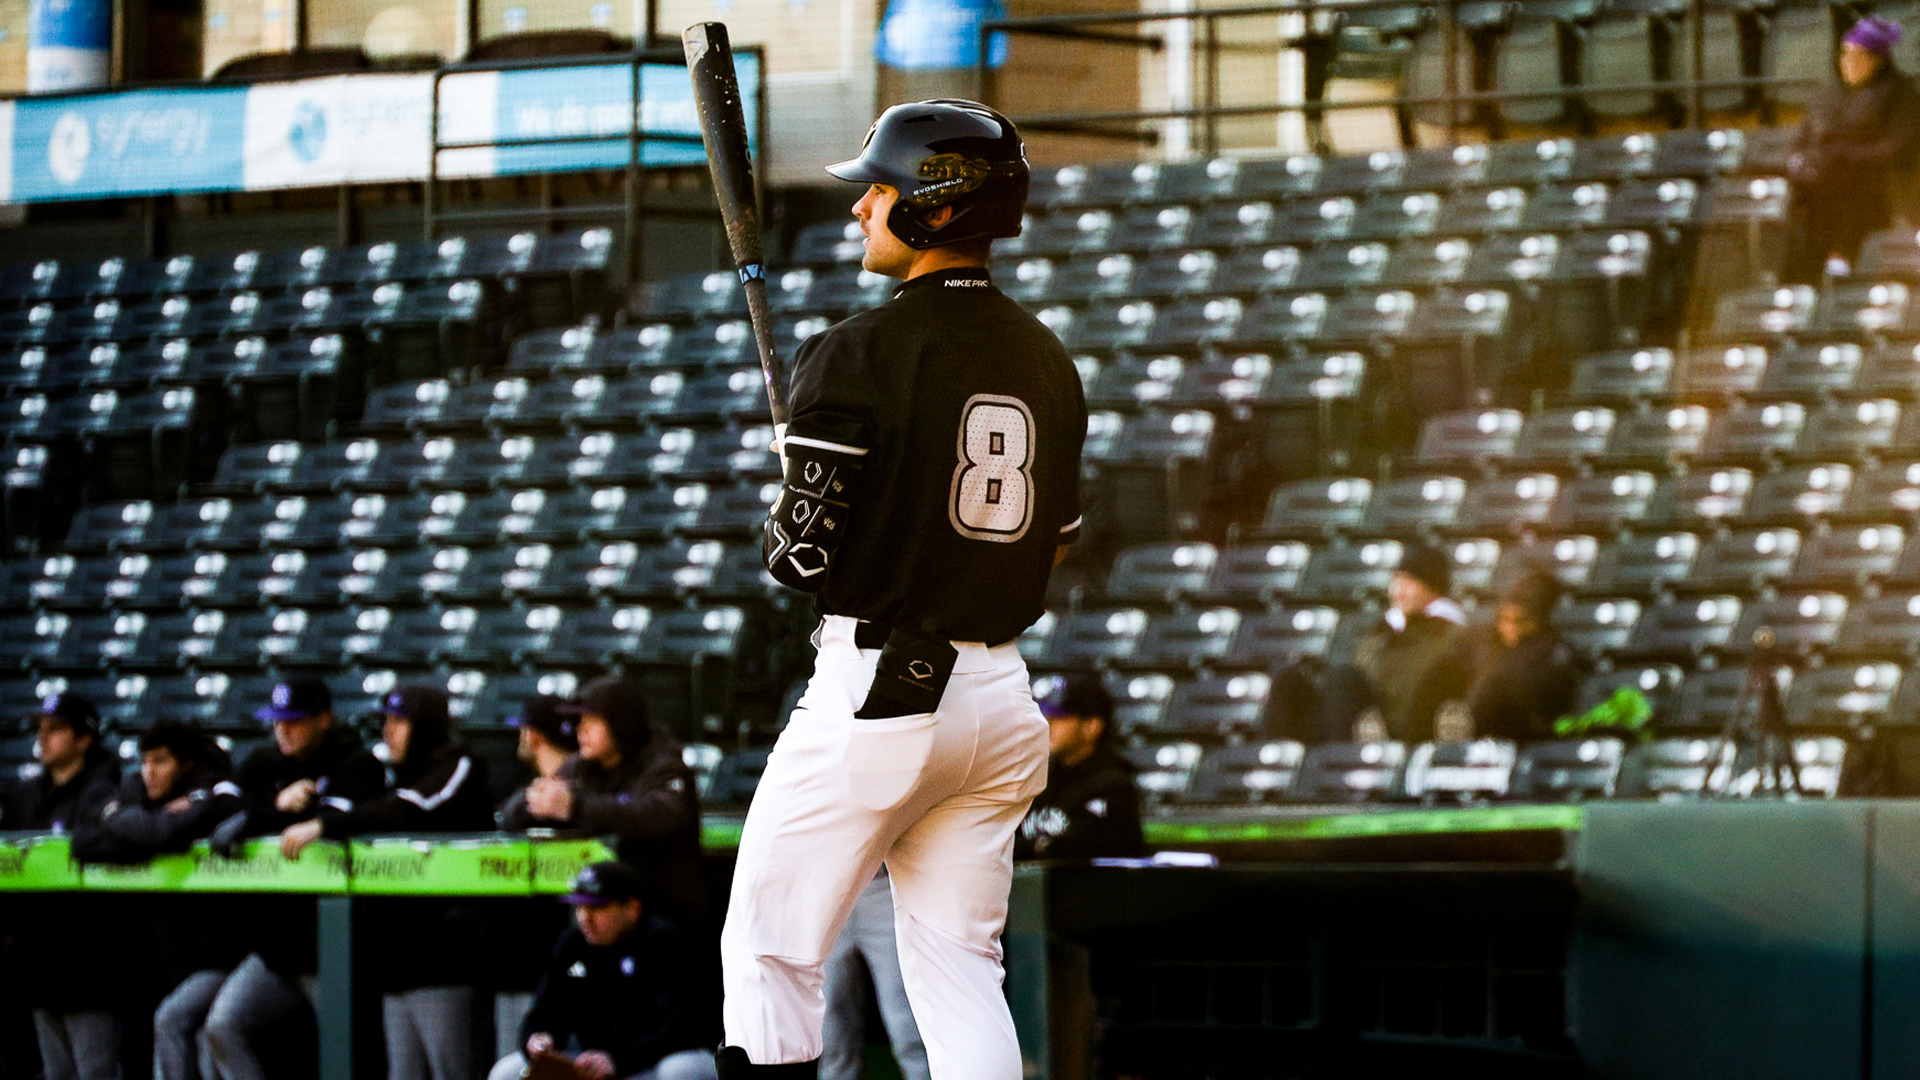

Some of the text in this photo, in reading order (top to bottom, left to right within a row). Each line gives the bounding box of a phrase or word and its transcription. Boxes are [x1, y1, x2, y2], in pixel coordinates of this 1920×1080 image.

[913, 177, 963, 196] EVOSHIELD
[944, 279, 971, 287] NIKE
[949, 393, 1036, 543] 8
